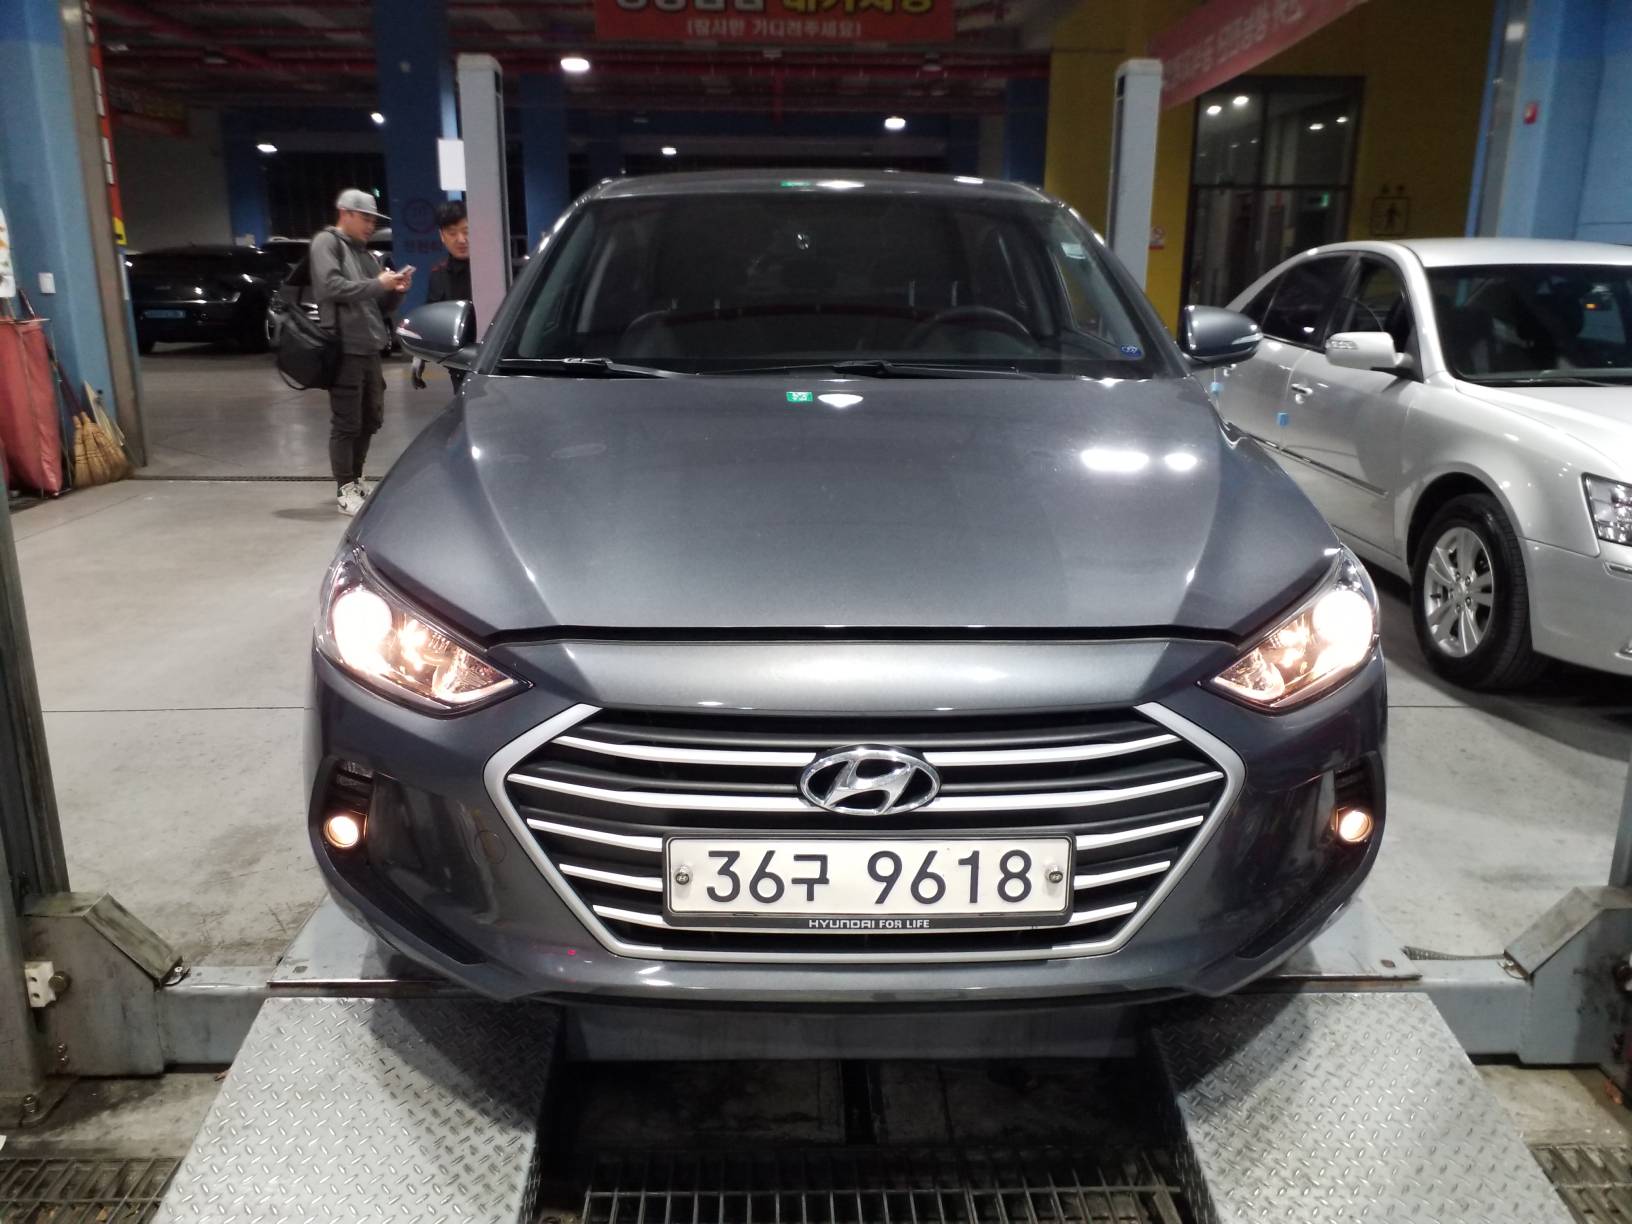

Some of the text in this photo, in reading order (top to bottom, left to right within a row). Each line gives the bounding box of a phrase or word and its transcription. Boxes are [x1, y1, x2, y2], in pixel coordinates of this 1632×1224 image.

[706, 849, 1032, 904] 36구 9618
[808, 919, 930, 929] HYUNDAI FOR LIFE
